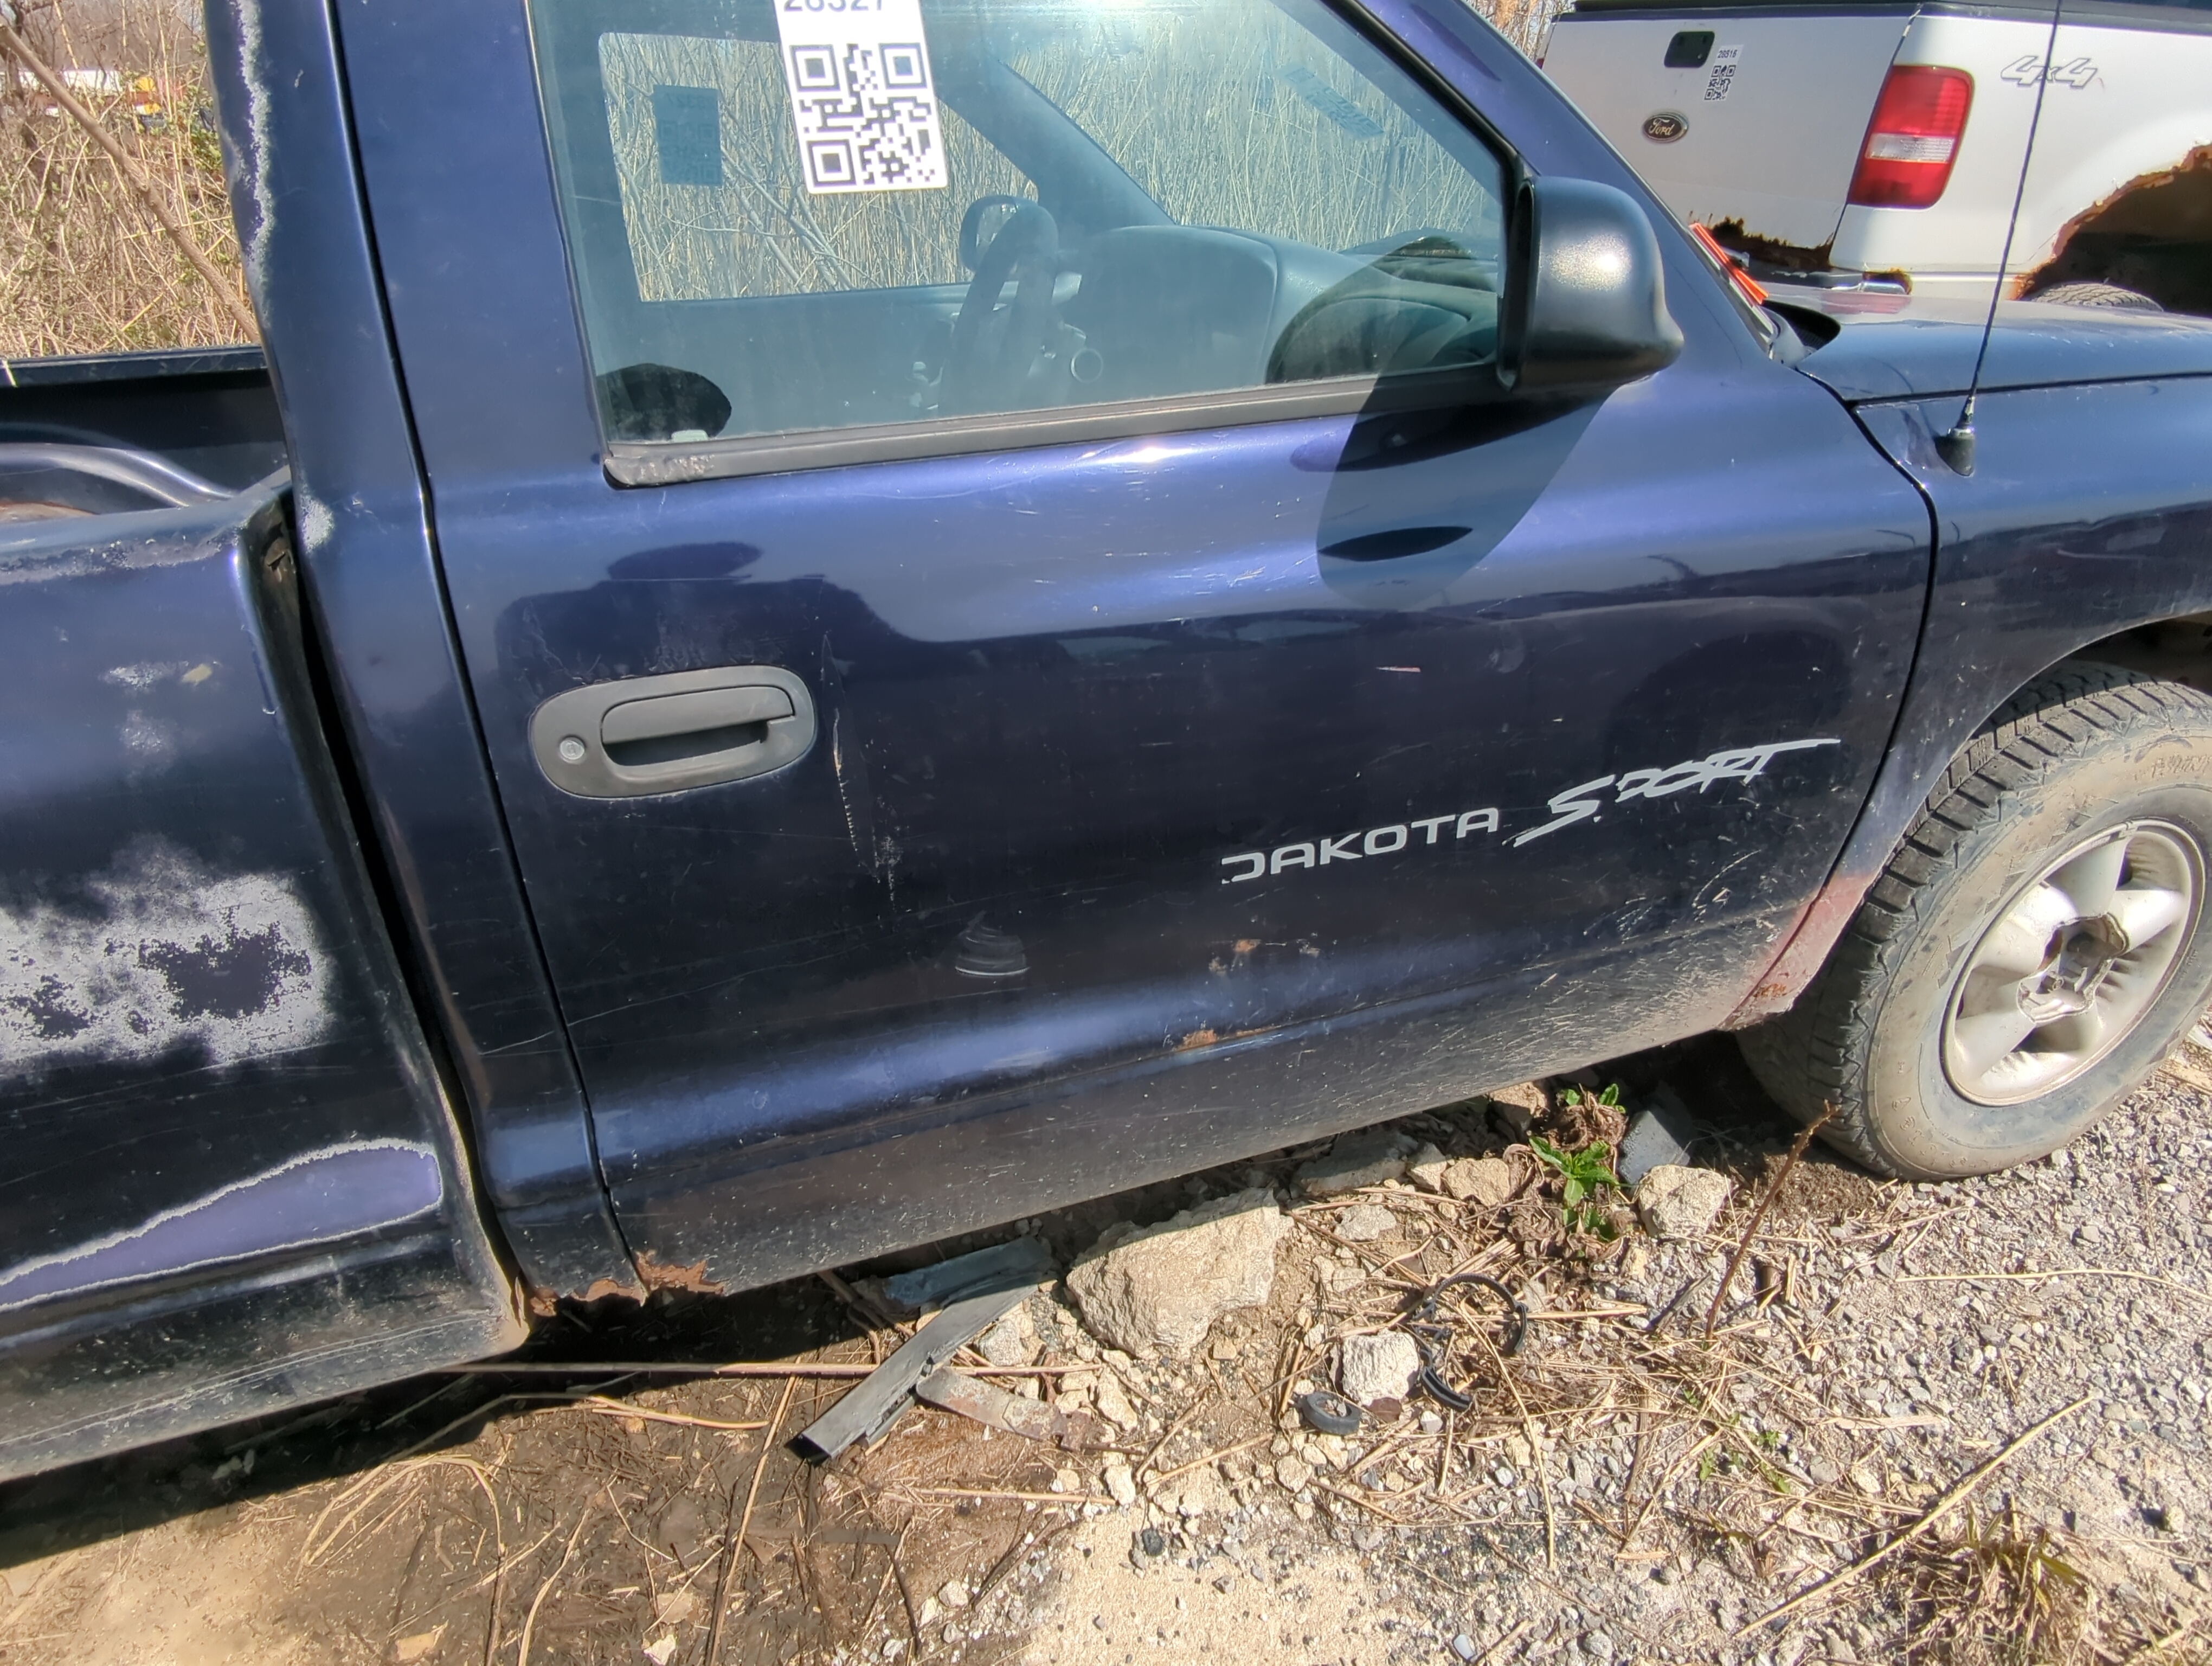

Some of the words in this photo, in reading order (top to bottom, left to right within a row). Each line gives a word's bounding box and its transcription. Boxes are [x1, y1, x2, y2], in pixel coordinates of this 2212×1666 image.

[1649, 118, 1675, 136] Ford
[1221, 807, 1499, 885] DAKOTA
[1513, 738, 1841, 848] SPORT
